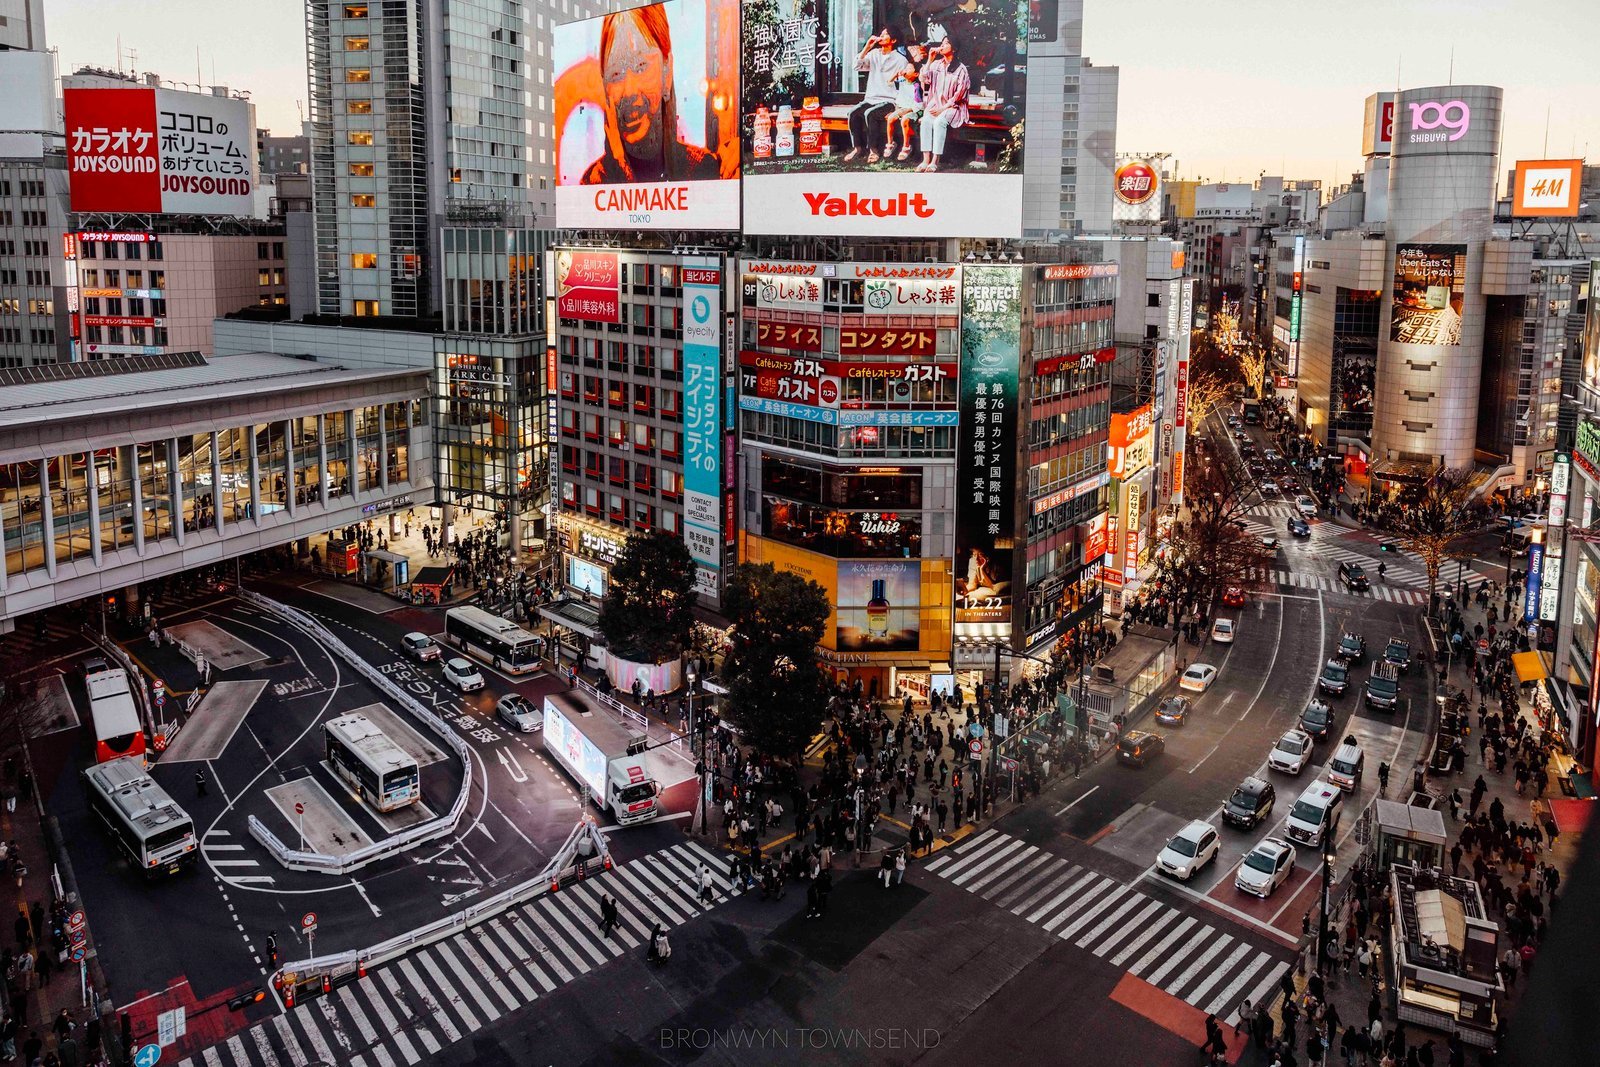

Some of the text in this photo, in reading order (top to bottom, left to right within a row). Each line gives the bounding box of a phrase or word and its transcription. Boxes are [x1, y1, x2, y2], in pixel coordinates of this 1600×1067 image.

[754, 17, 826, 48] 強い菌で、
[754, 42, 841, 73] 強く生きる。
[160, 112, 228, 135] ココロの
[1409, 100, 1470, 141] 109
[72, 127, 153, 153] カラオケ
[162, 134, 248, 159] ボリューム、
[1410, 134, 1447, 142] SHIBUYA
[73, 155, 156, 173] JOYSOUND
[163, 156, 249, 175] あげていこう。
[162, 175, 250, 195] JOYSOUND
[1121, 176, 1150, 191] 楽園
[1531, 179, 1564, 197] H&M
[595, 187, 688, 211] CANMAKE
[802, 192, 935, 218] Yakult
[629, 214, 650, 223] TOKYO
[583, 260, 614, 271] 品川スキン
[748, 262, 817, 276] しゃぶしゃぶバイキング
[1400, 258, 1418, 267] Uber
[583, 272, 611, 283] クリニック
[686, 271, 716, 281] 当ビル5F
[855, 266, 955, 278] しゃぶしゃぶバイキング
[744, 284, 756, 295] 9F
[779, 282, 819, 301] しゃぶ葉
[897, 286, 956, 305] しゃぶ葉
[966, 287, 1020, 299] PERFECT
[566, 299, 615, 315] 品川美容外科
[977, 300, 1007, 312] DAYS
[1182, 299, 1191, 336] CAMERA
[687, 327, 715, 339] eyecity
[759, 325, 820, 346] プライス
[841, 332, 932, 349] コンタクト
[482, 372, 512, 382] CIY
[794, 359, 824, 377] ガスト
[904, 365, 947, 382] ガスト
[743, 375, 756, 386] 7F
[777, 378, 815, 400] ガスト
[687, 364, 702, 470] アイシティ
[704, 366, 715, 472] コンタクトの
[765, 401, 819, 419] 英会話イーオン
[844, 413, 956, 424] AEON 英会話イーオン
[973, 383, 987, 504] 最優秀男優賞 受賞
[988, 383, 1004, 535] 第76回カンヌ国際映画祭
[691, 496, 712, 507] CONTACT
[688, 509, 716, 523] SPECIALISTS
[860, 521, 900, 533] Ushi8
[582, 532, 624, 559] サンドラ
[1532, 549, 1540, 574] MIZUHO
[1081, 561, 1100, 582] LUSH
[964, 597, 1003, 609] 12.22
[815, 646, 870, 663] OCCITANE
